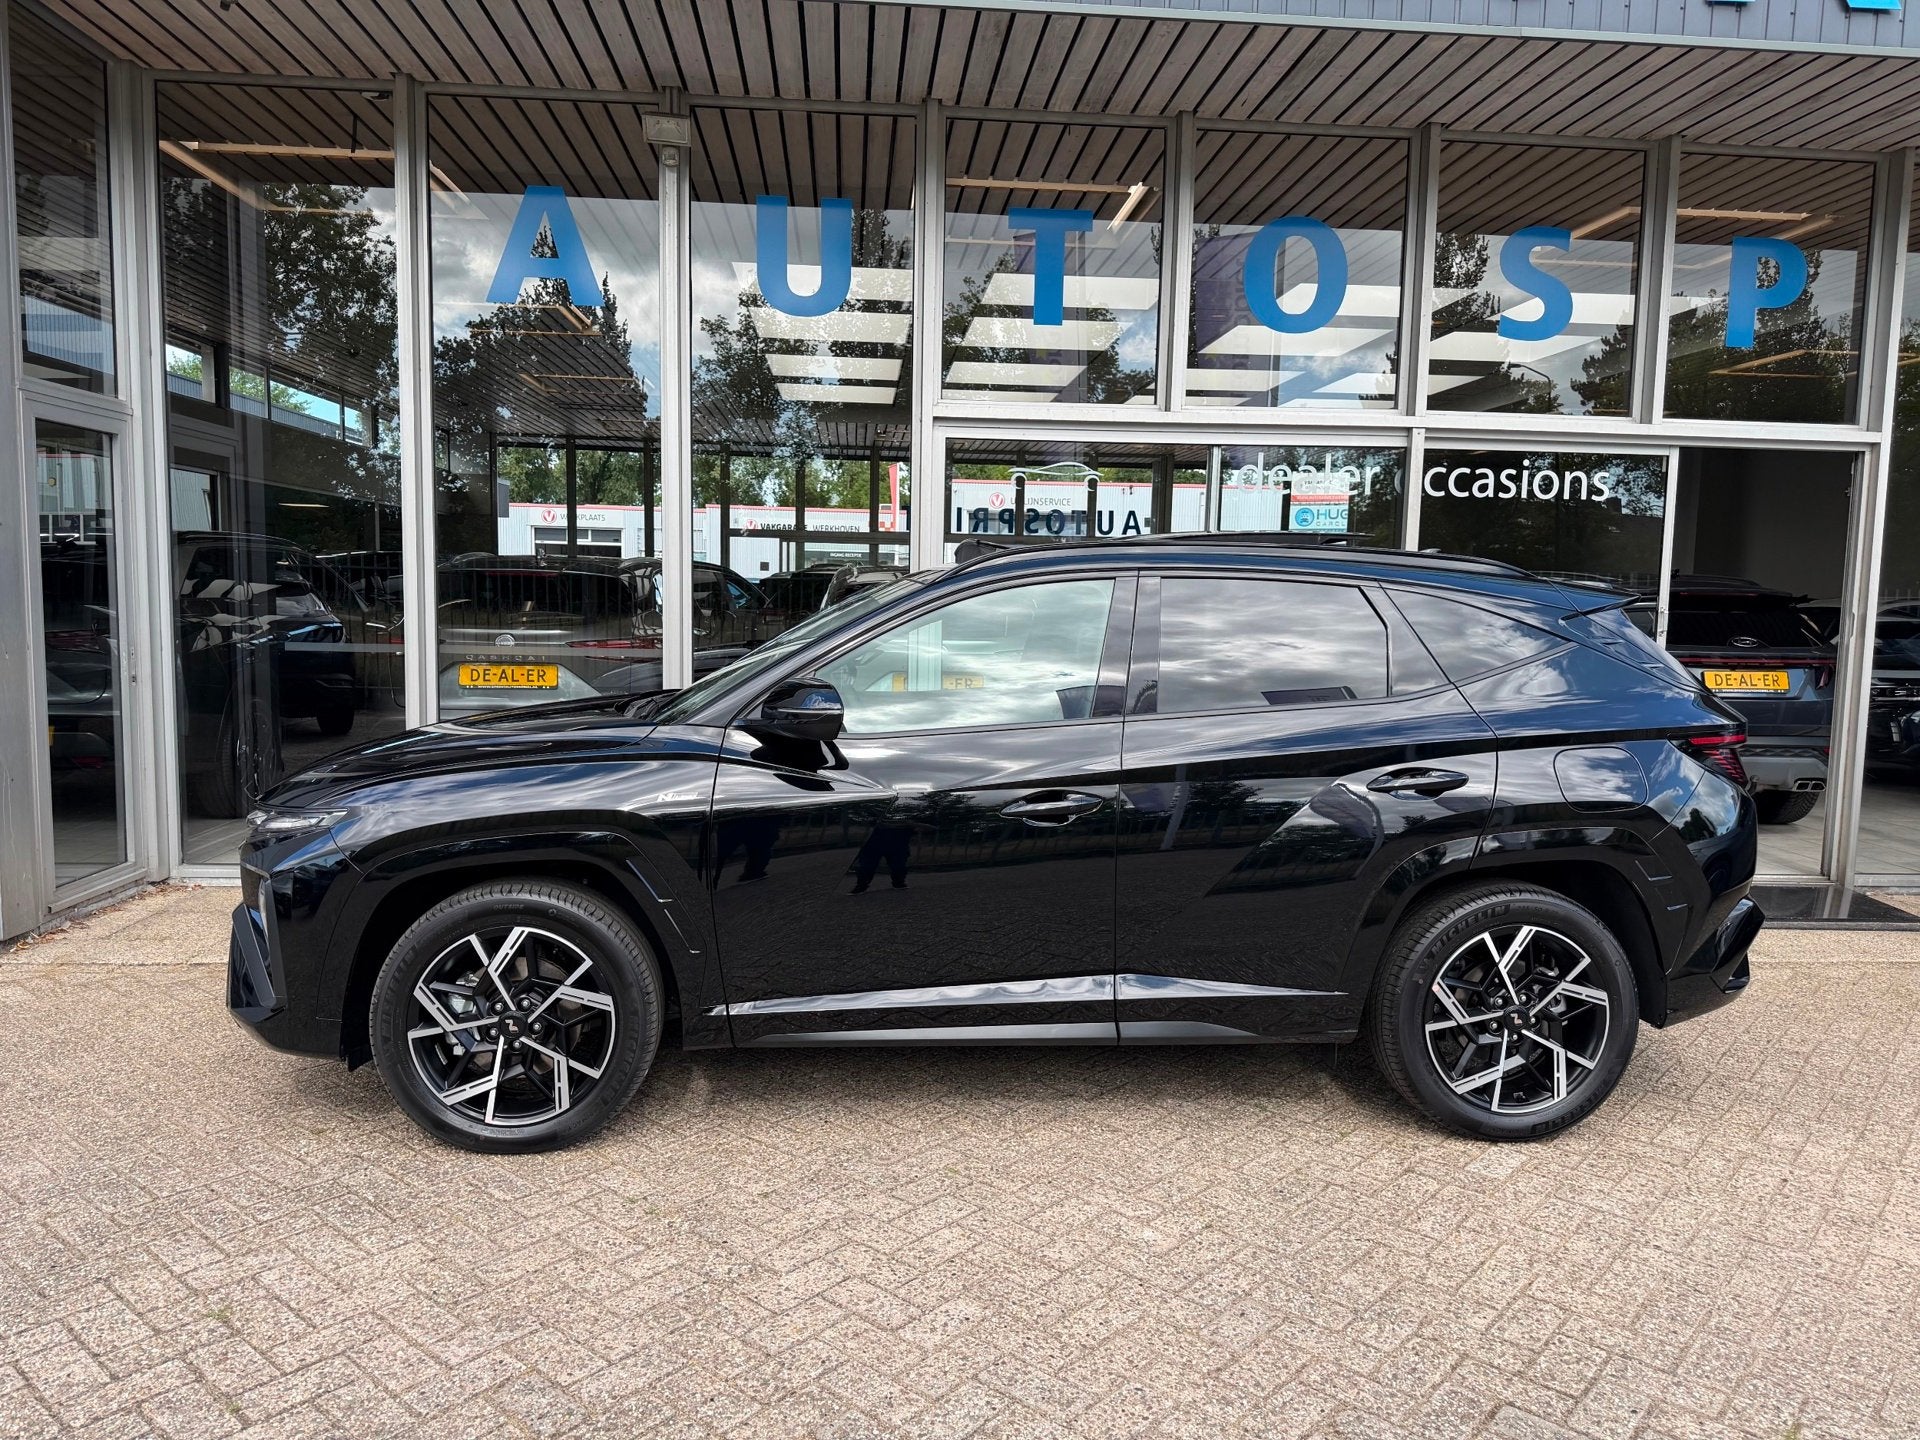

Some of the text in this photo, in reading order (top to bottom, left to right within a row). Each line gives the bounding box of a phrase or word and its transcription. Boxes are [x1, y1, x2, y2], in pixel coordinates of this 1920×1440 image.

[1237, 452, 1381, 496] dealer
[1394, 459, 1610, 501] ccasions
[1010, 497, 1072, 506] UIJNSERVICE
[560, 513, 606, 522] WKPLAATS
[760, 522, 808, 531] VAKGARAE
[470, 668, 547, 682] DE-AL-ER
[1714, 673, 1781, 688] DE-AL-ER
